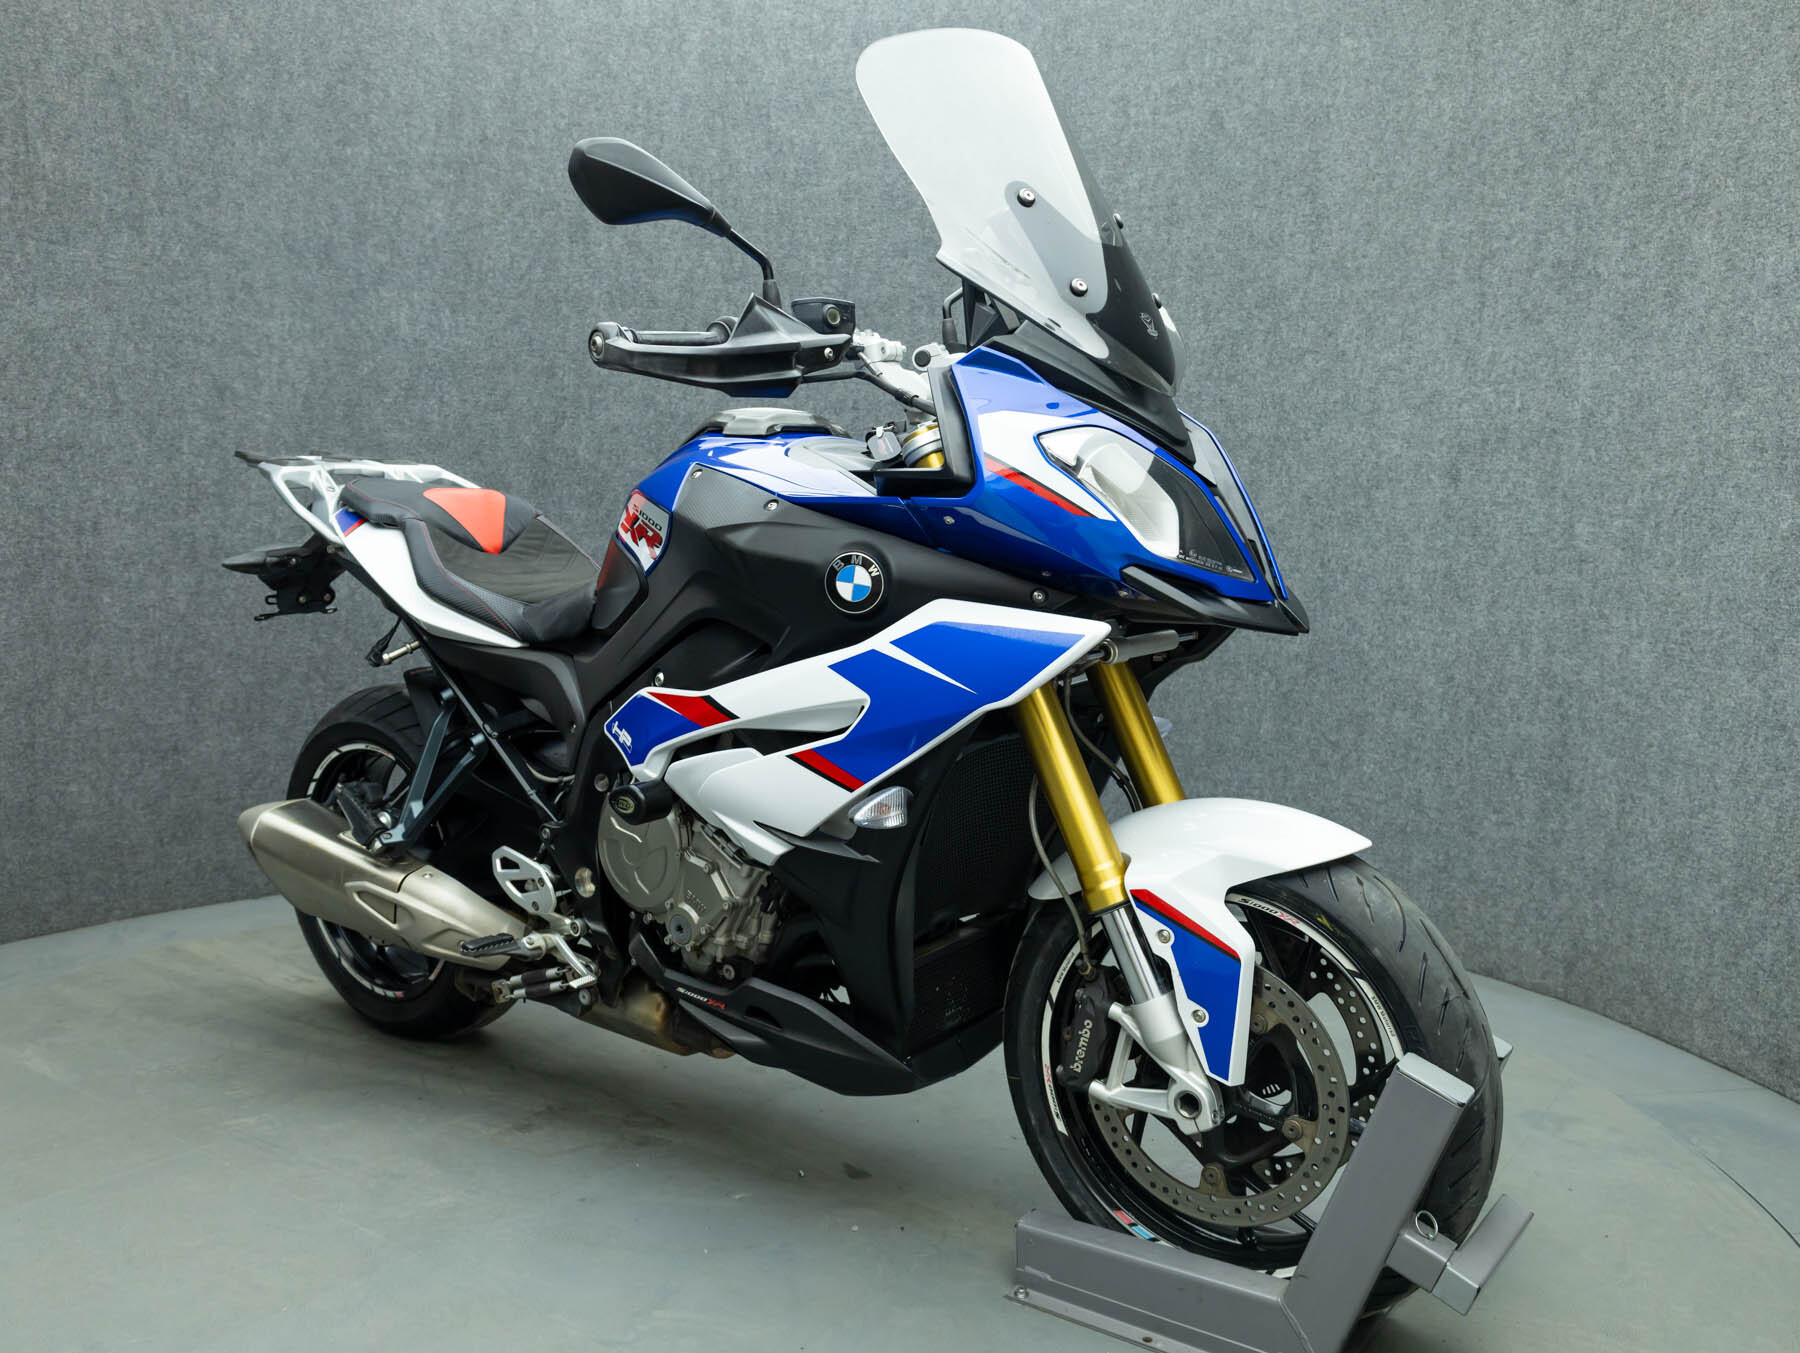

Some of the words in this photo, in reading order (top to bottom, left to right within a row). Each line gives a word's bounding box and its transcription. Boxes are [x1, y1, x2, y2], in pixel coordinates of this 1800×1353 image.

[632, 503, 663, 532] S1000
[832, 554, 880, 578] BMW
[1069, 1018, 1093, 1073] brembo
